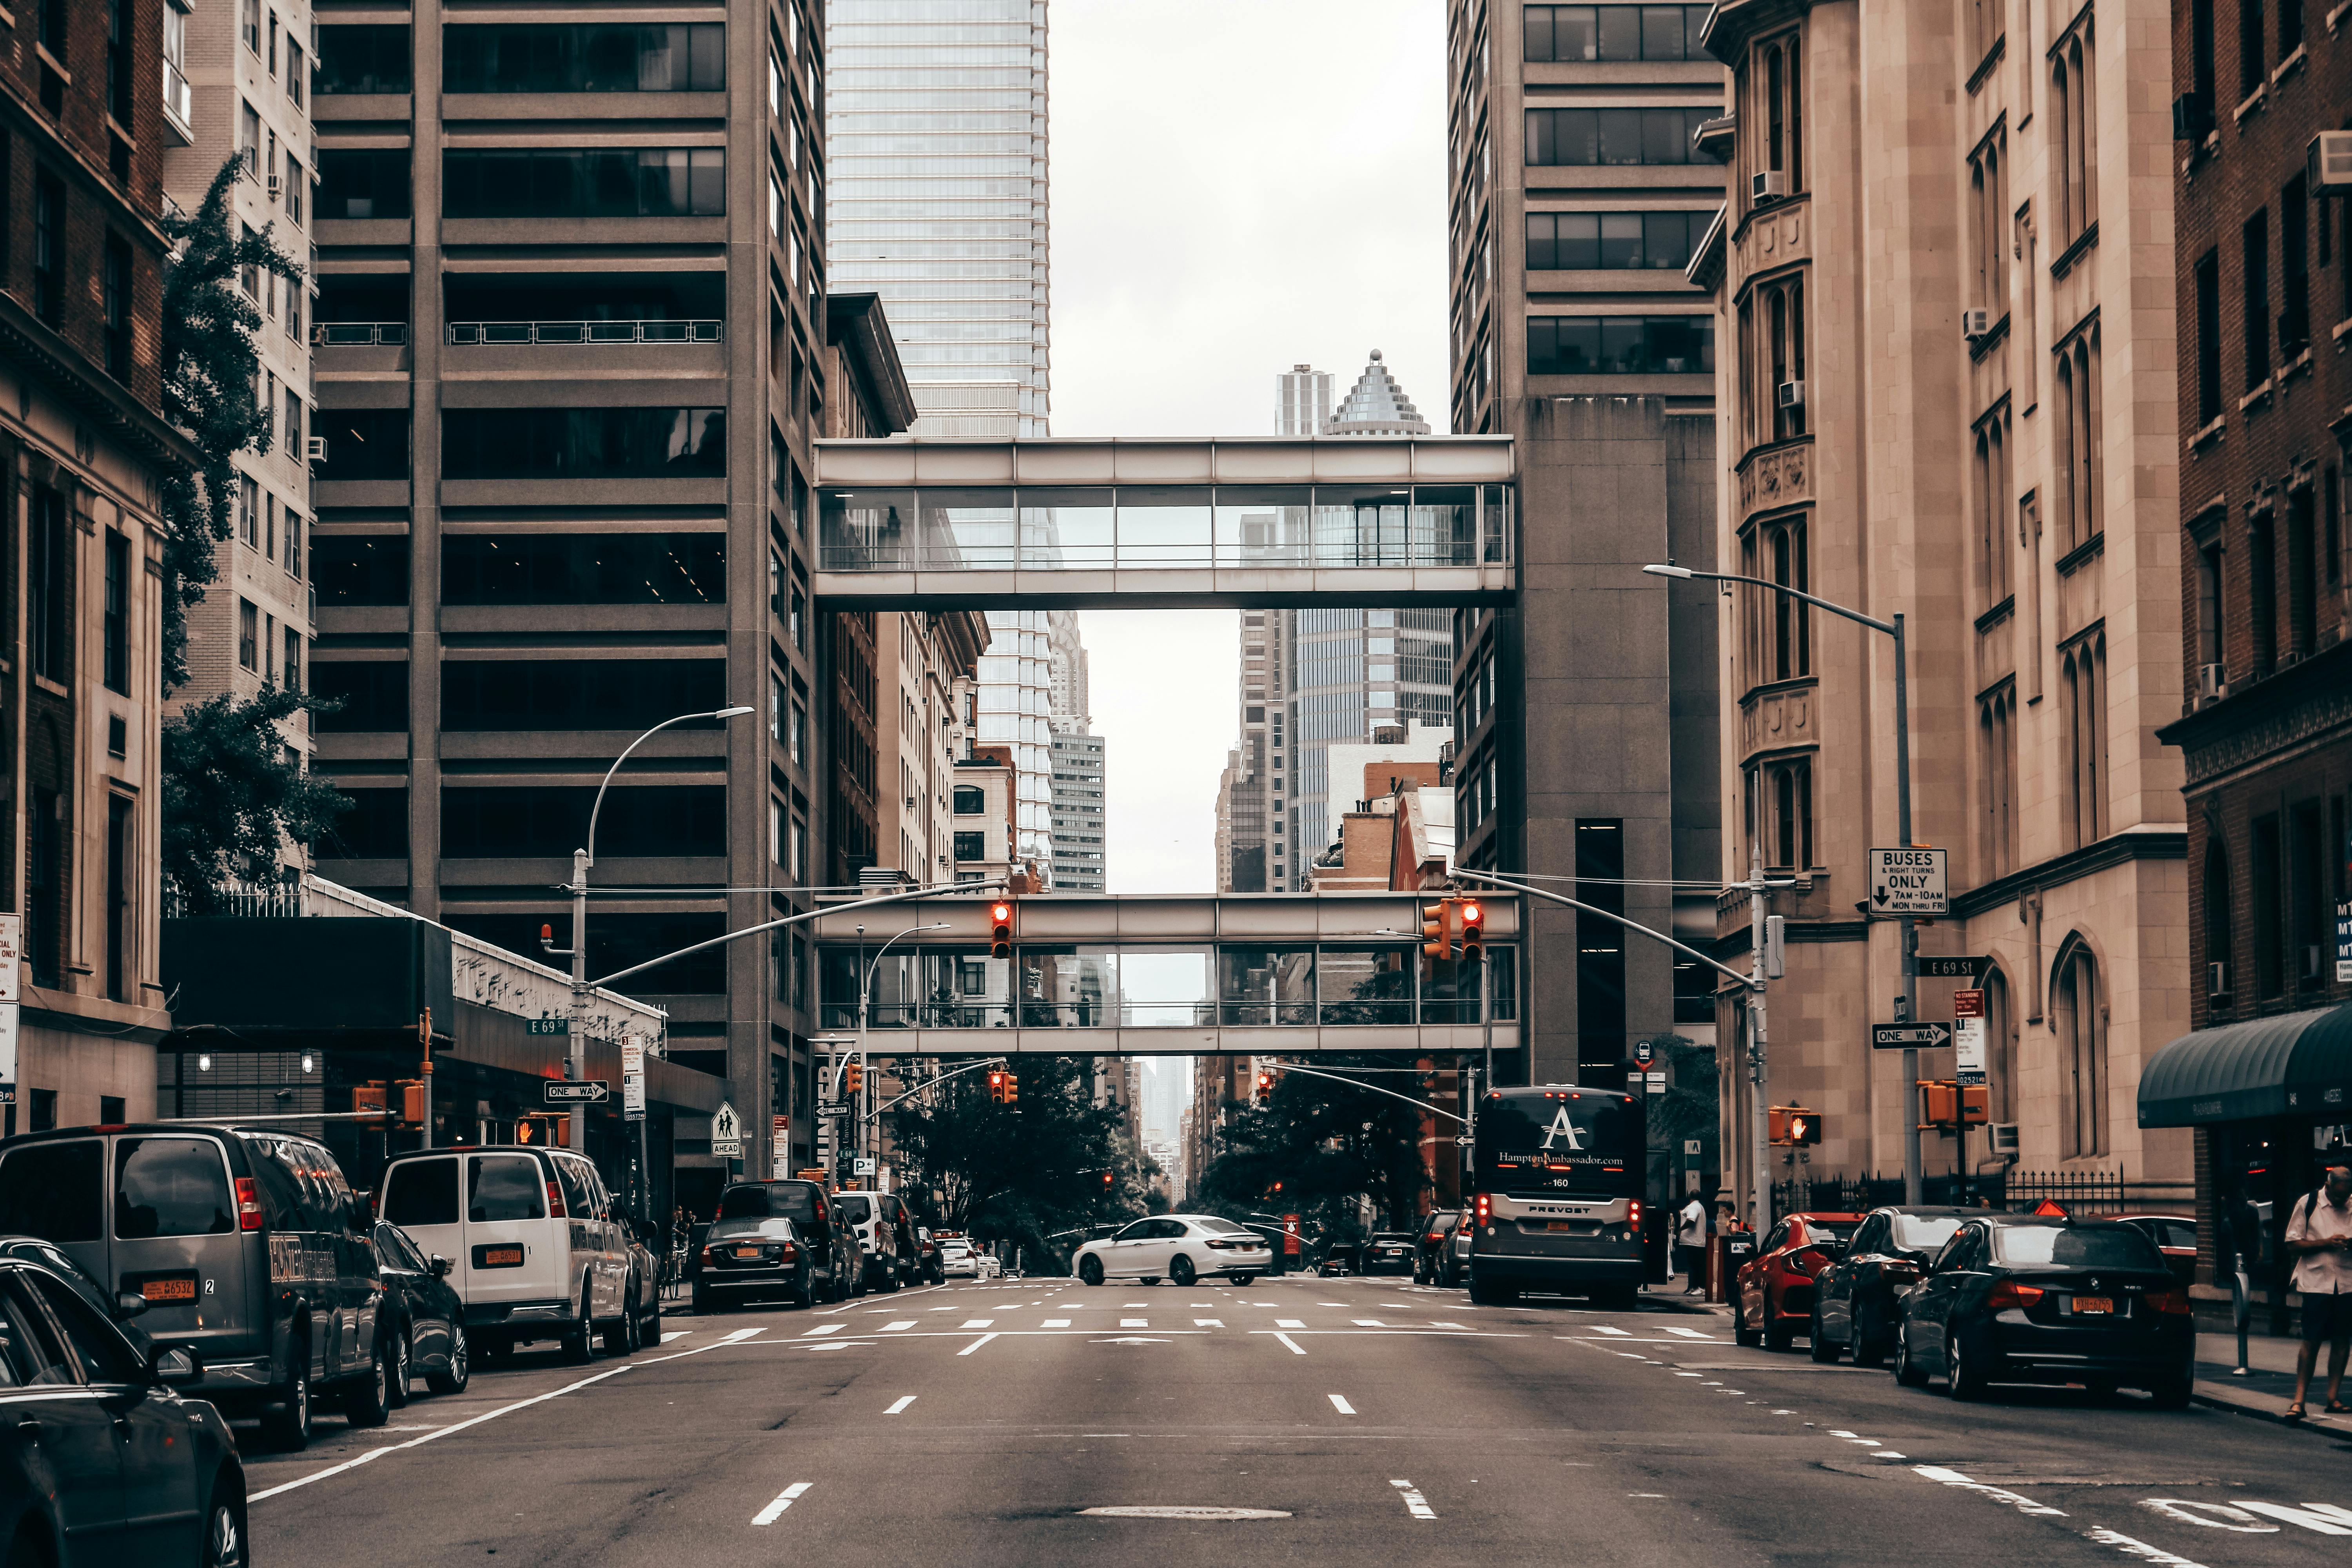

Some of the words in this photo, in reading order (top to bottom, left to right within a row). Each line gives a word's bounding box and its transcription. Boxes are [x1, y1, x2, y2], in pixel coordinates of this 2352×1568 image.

[1884, 852, 1933, 866] BUSES
[1889, 875, 1927, 888] ONLY
[1933, 963, 1937, 974] E
[1943, 963, 1956, 974] 69
[1962, 962, 1972, 974] St
[532, 1022, 537, 1032] E
[543, 1021, 554, 1032] 69
[1959, 1019, 1962, 1029] 1
[1880, 1031, 1902, 1041] ONE
[1916, 1030, 1940, 1040] WAY
[1539, 1105, 1586, 1149] A
[528, 1246, 531, 1255] 1
[269, 1236, 304, 1283] HUNTER
[304, 1251, 336, 1281] ATHLETICS
[206, 1281, 212, 1294] 2
